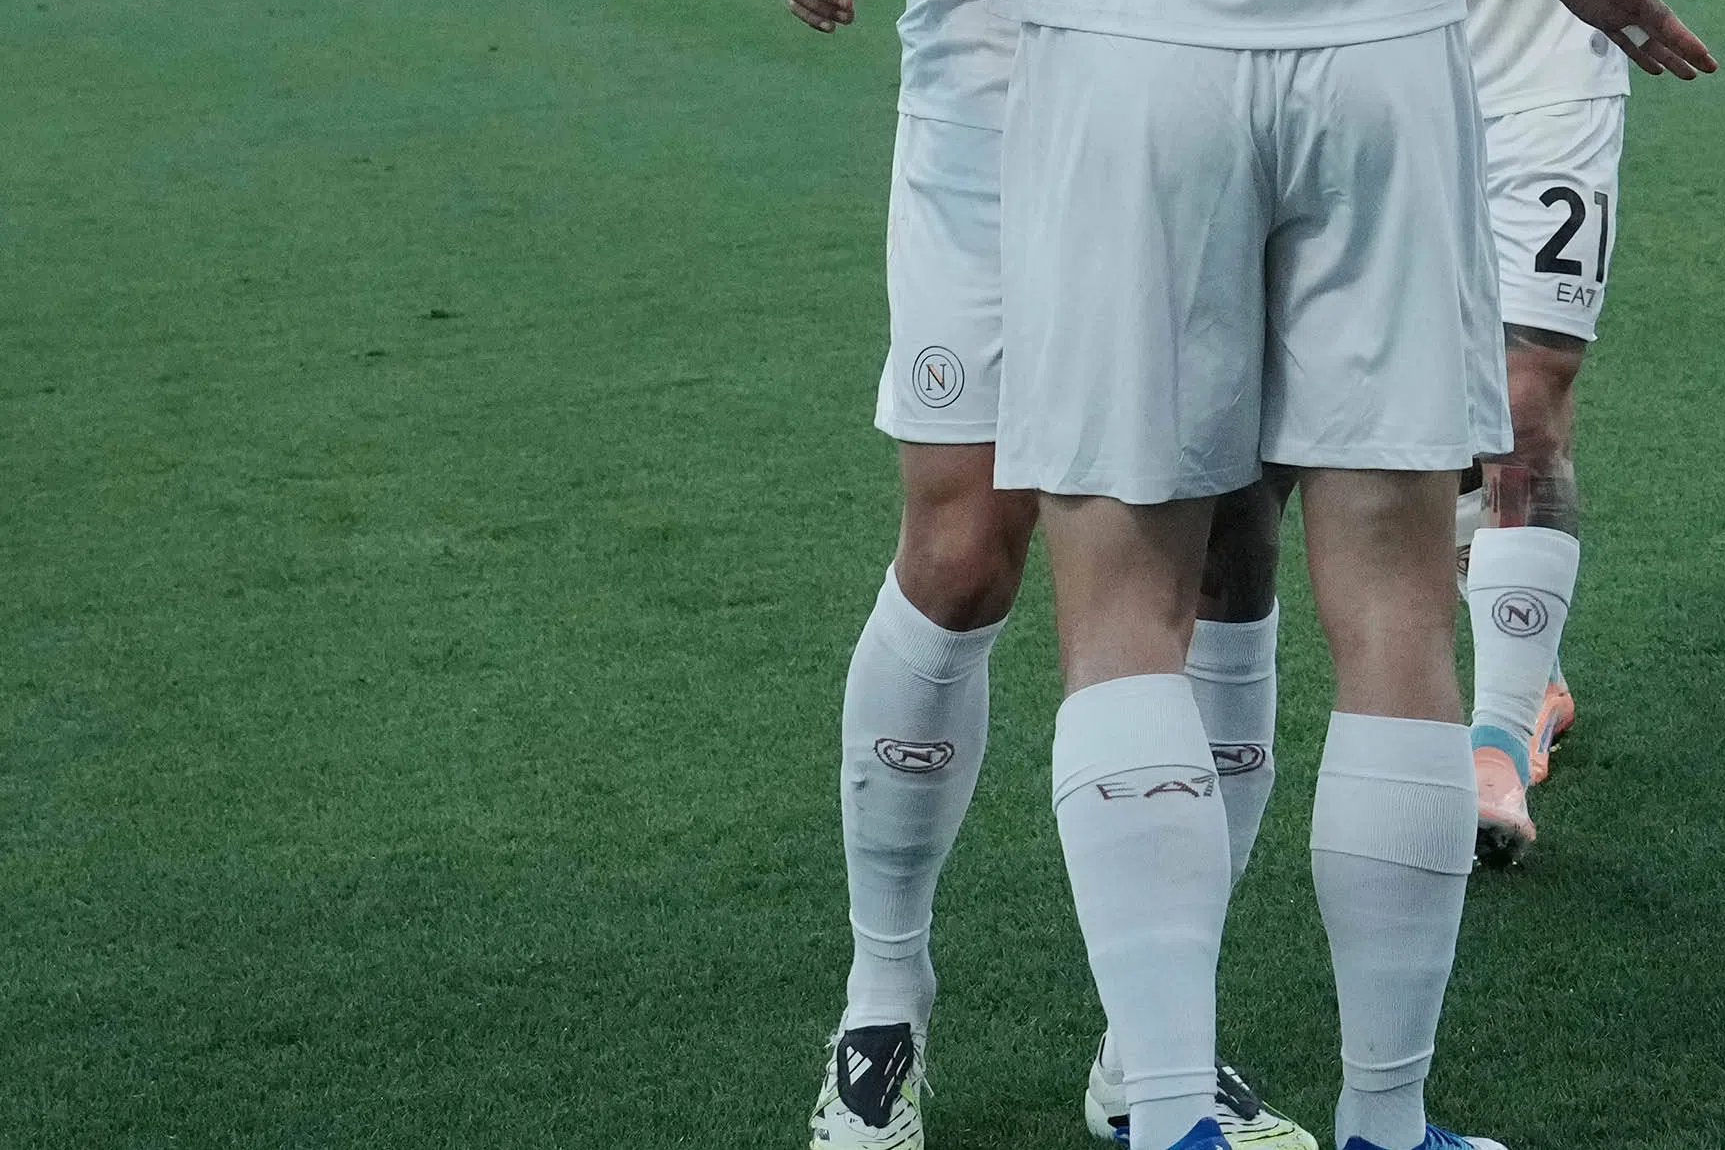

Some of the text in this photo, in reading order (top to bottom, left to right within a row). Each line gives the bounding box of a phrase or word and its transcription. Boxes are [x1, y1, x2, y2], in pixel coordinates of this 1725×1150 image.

[1535, 186, 1608, 283] 21
[1556, 282, 1597, 308] EA7
[926, 363, 947, 391] N
[1505, 605, 1533, 626] N
